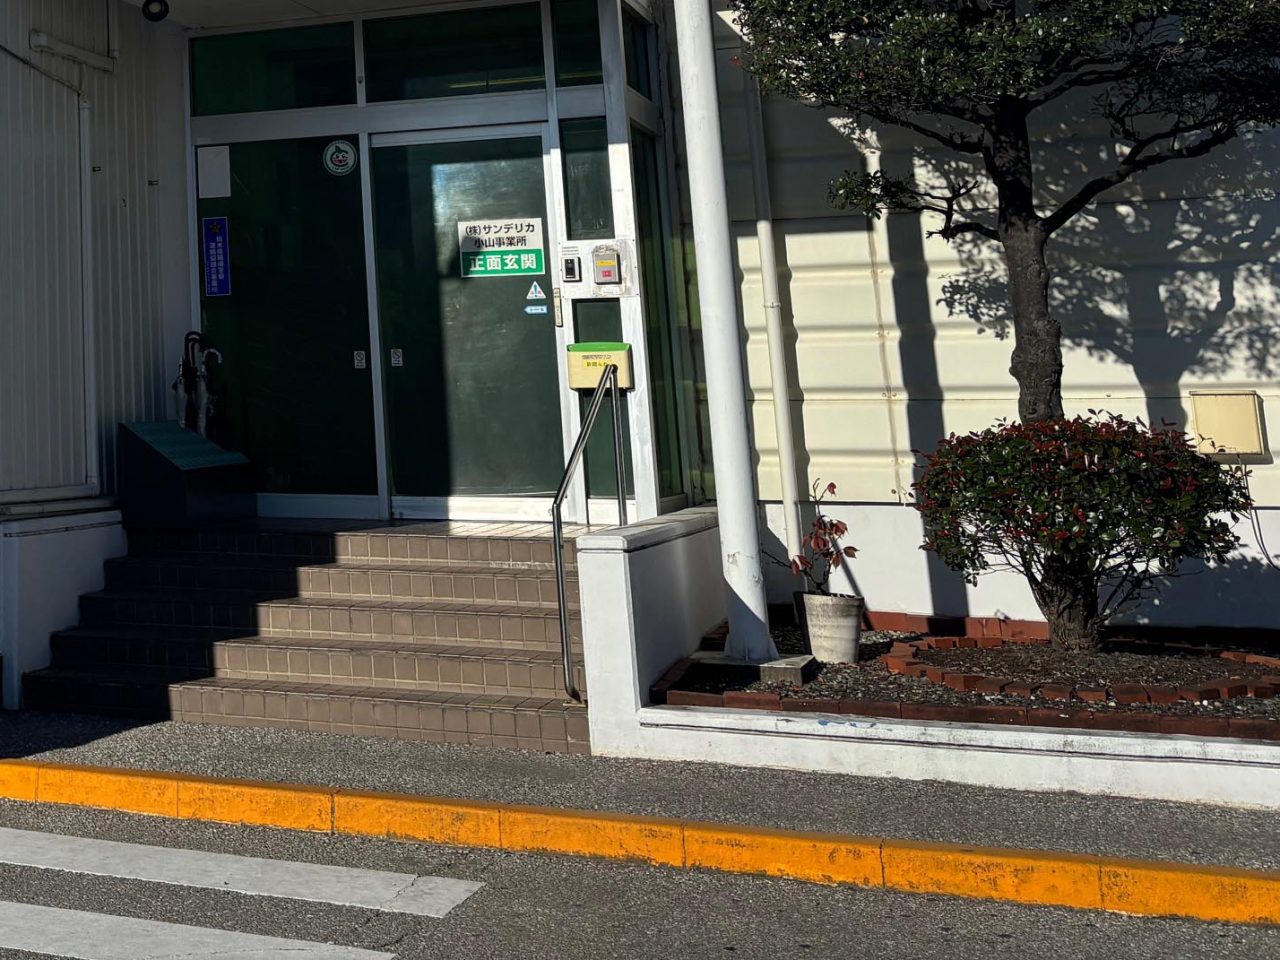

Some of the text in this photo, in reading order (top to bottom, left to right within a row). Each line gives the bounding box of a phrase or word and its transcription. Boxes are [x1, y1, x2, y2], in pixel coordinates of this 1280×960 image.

[465, 222, 535, 236] (株)サンデリカ
[474, 235, 527, 248] 小山事業所
[469, 253, 537, 271] 正面玄関
